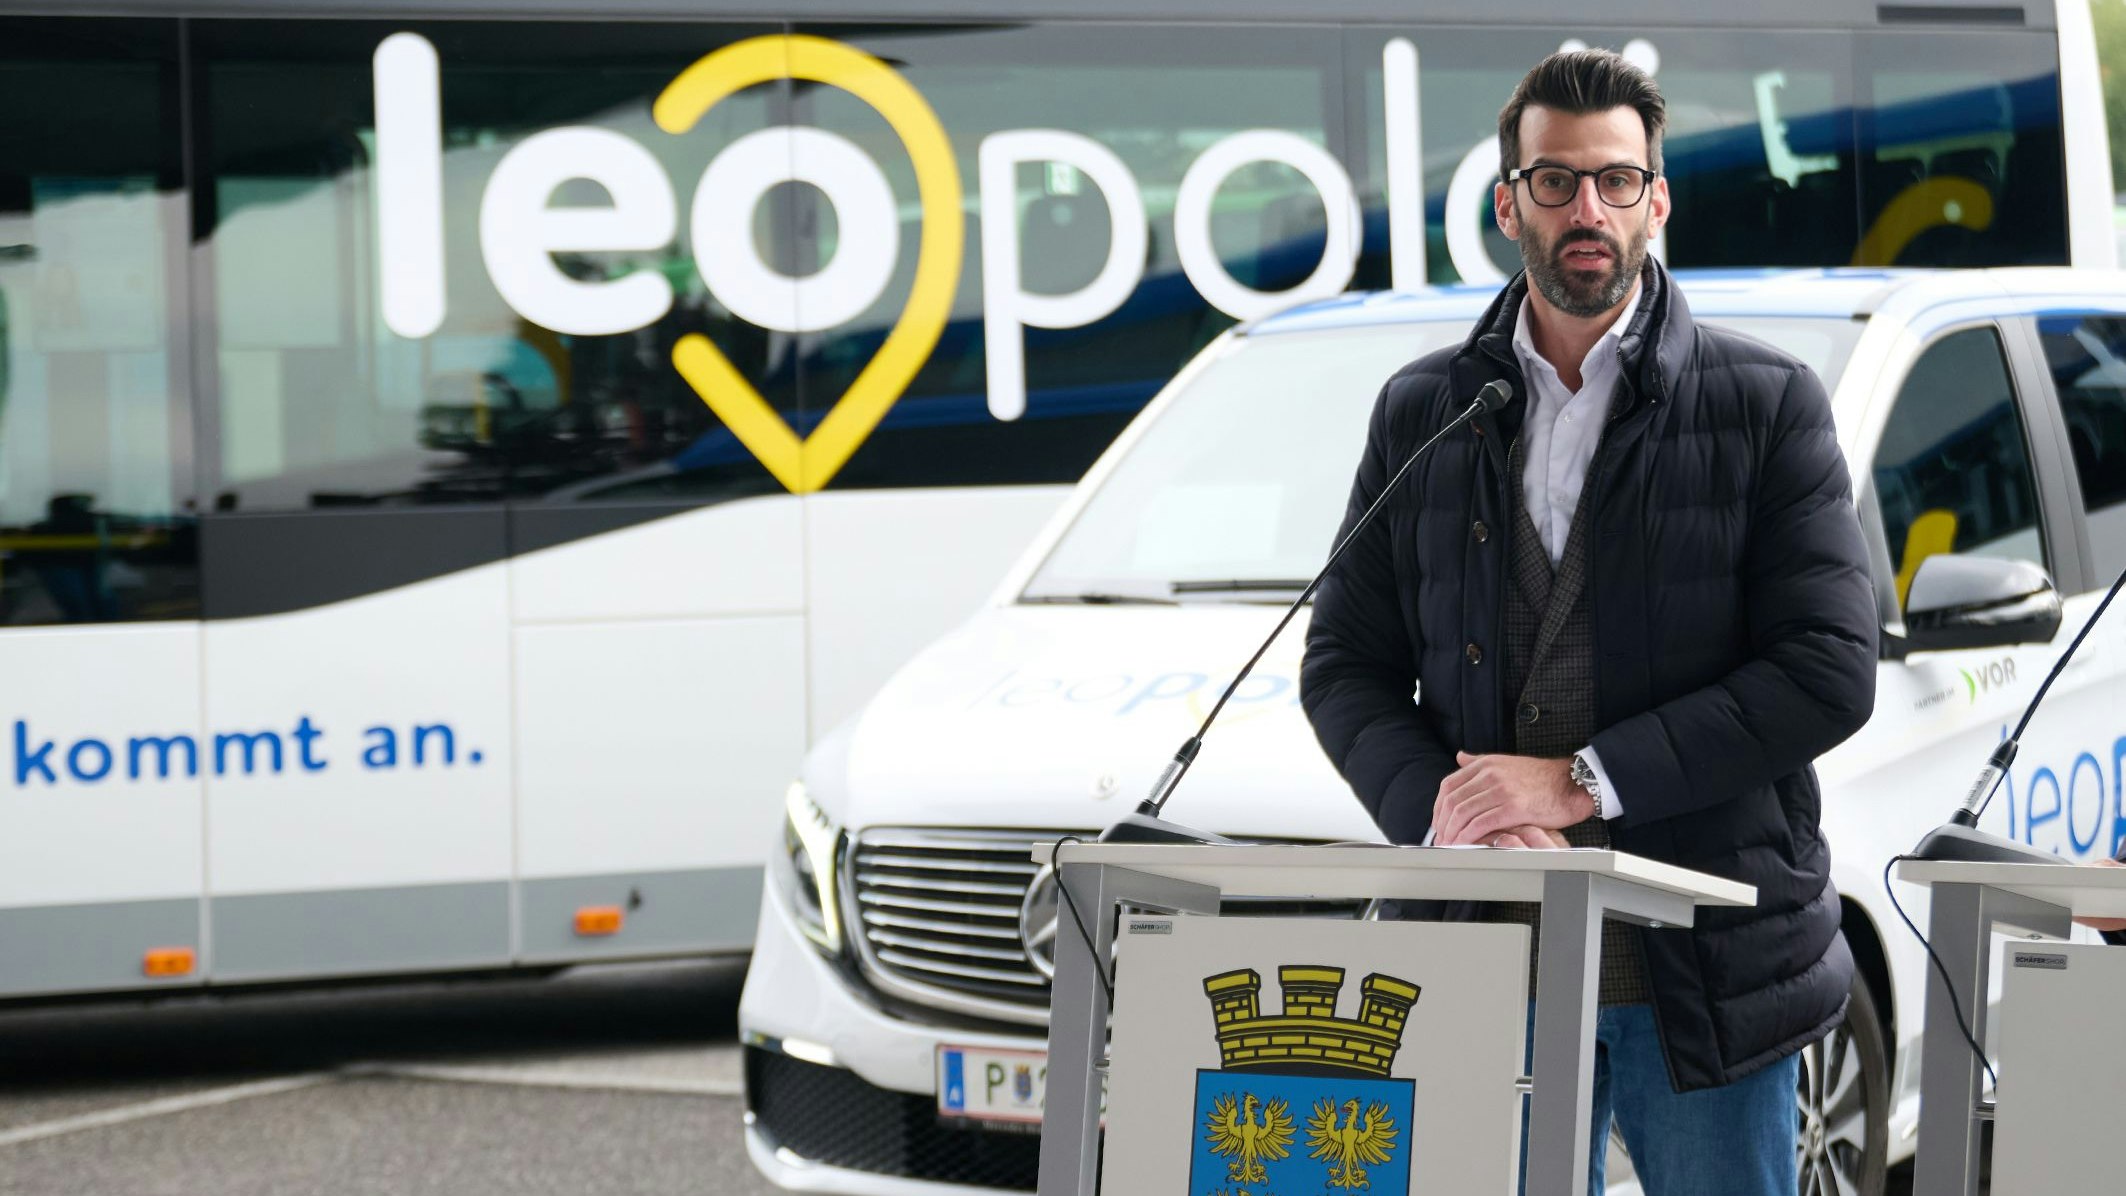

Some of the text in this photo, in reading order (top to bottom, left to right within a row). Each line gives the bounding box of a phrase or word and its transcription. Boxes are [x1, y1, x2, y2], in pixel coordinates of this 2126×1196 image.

[373, 31, 1668, 421] leopol
[1976, 656, 2016, 693] VOR
[14, 716, 484, 786] kommt an.
